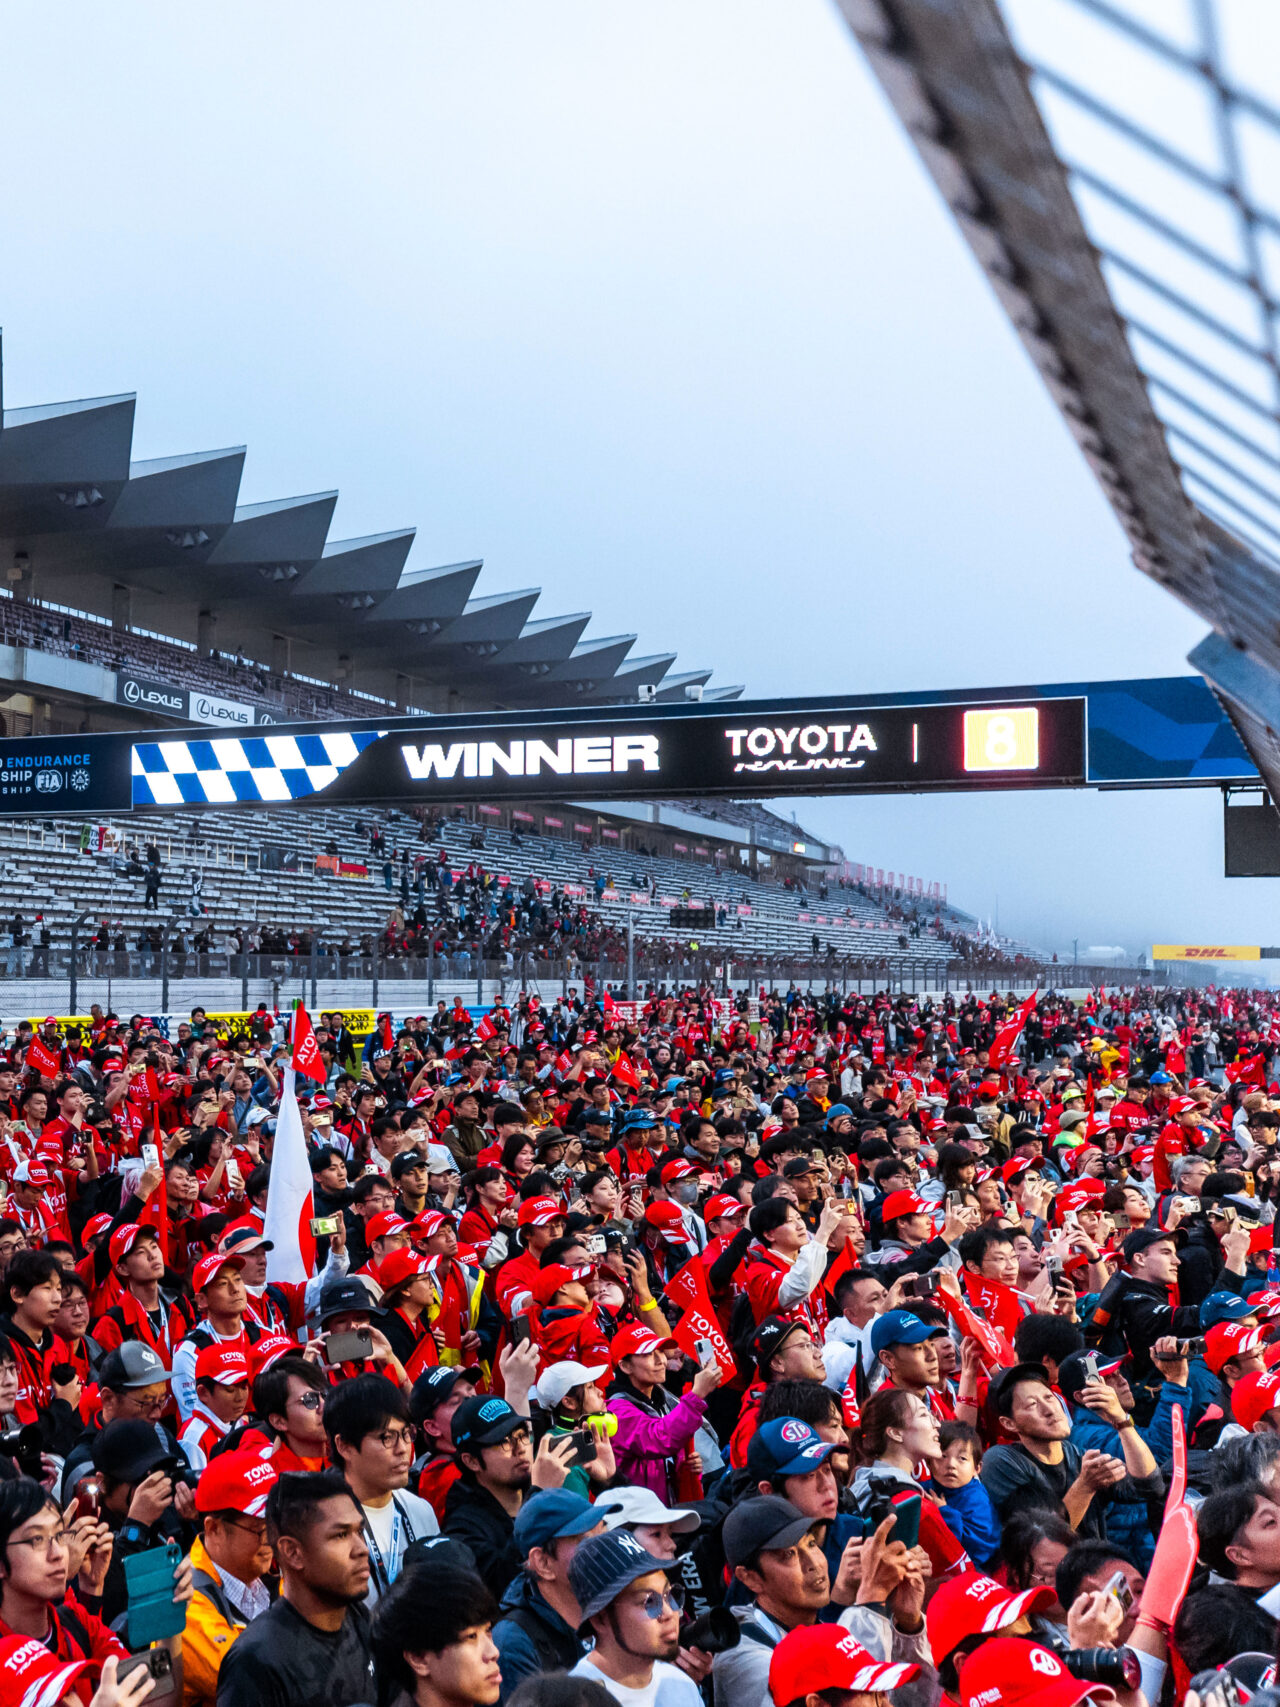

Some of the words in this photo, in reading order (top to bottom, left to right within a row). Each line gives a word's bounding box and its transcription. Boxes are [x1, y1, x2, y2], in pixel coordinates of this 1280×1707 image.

[140, 691, 182, 709] LEXUS
[211, 705, 248, 724] LEXUS
[725, 725, 877, 756] TOYOTA
[985, 716, 1016, 763] 8
[7, 754, 91, 768] ENDURANCE
[401, 735, 660, 779] WINNER
[1185, 948, 1228, 957] DHL
[690, 1311, 734, 1364] TOYOTA
[785, 1422, 810, 1441] STP
[403, 1517, 416, 1543] ONY
[680, 1551, 703, 1590] ERA
